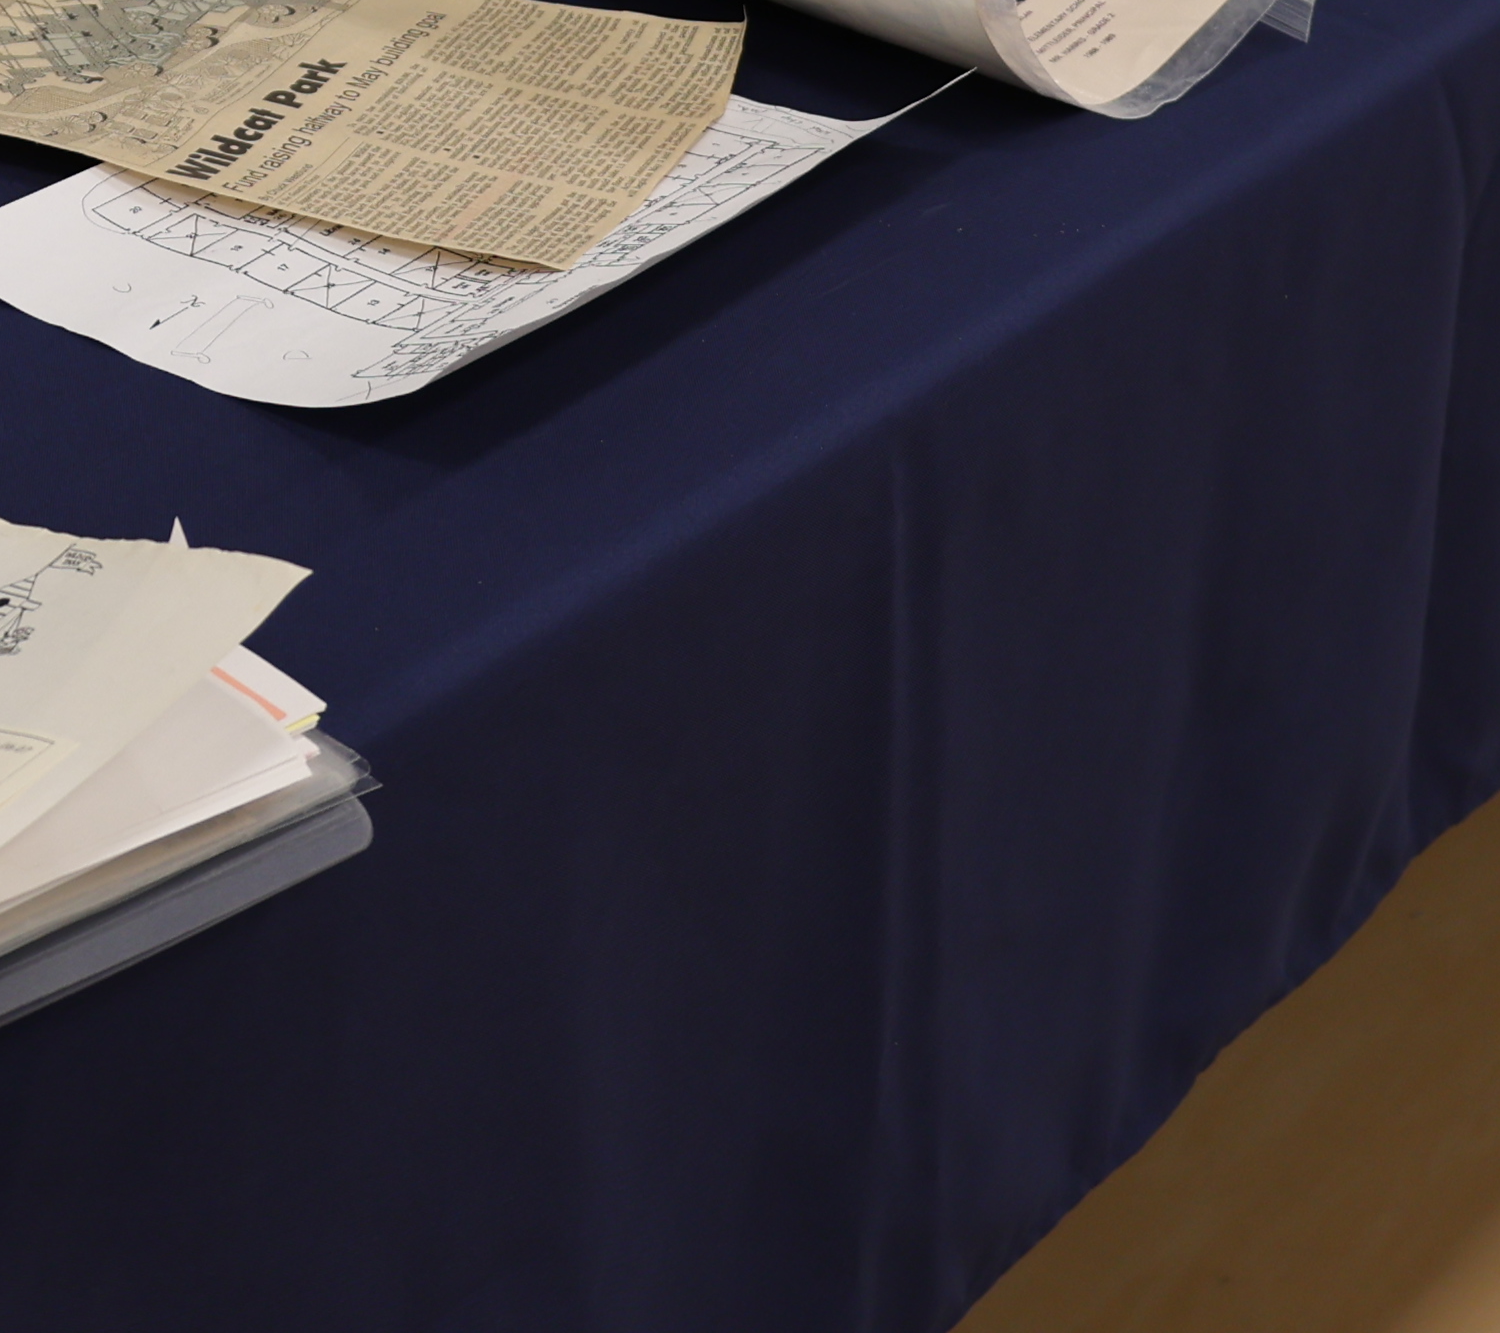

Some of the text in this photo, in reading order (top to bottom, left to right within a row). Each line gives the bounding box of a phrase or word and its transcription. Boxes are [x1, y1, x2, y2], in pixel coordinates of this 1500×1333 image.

[165, 58, 348, 181] Wildcat Park
[222, 10, 447, 194] Fund raising halfway to May building goal
